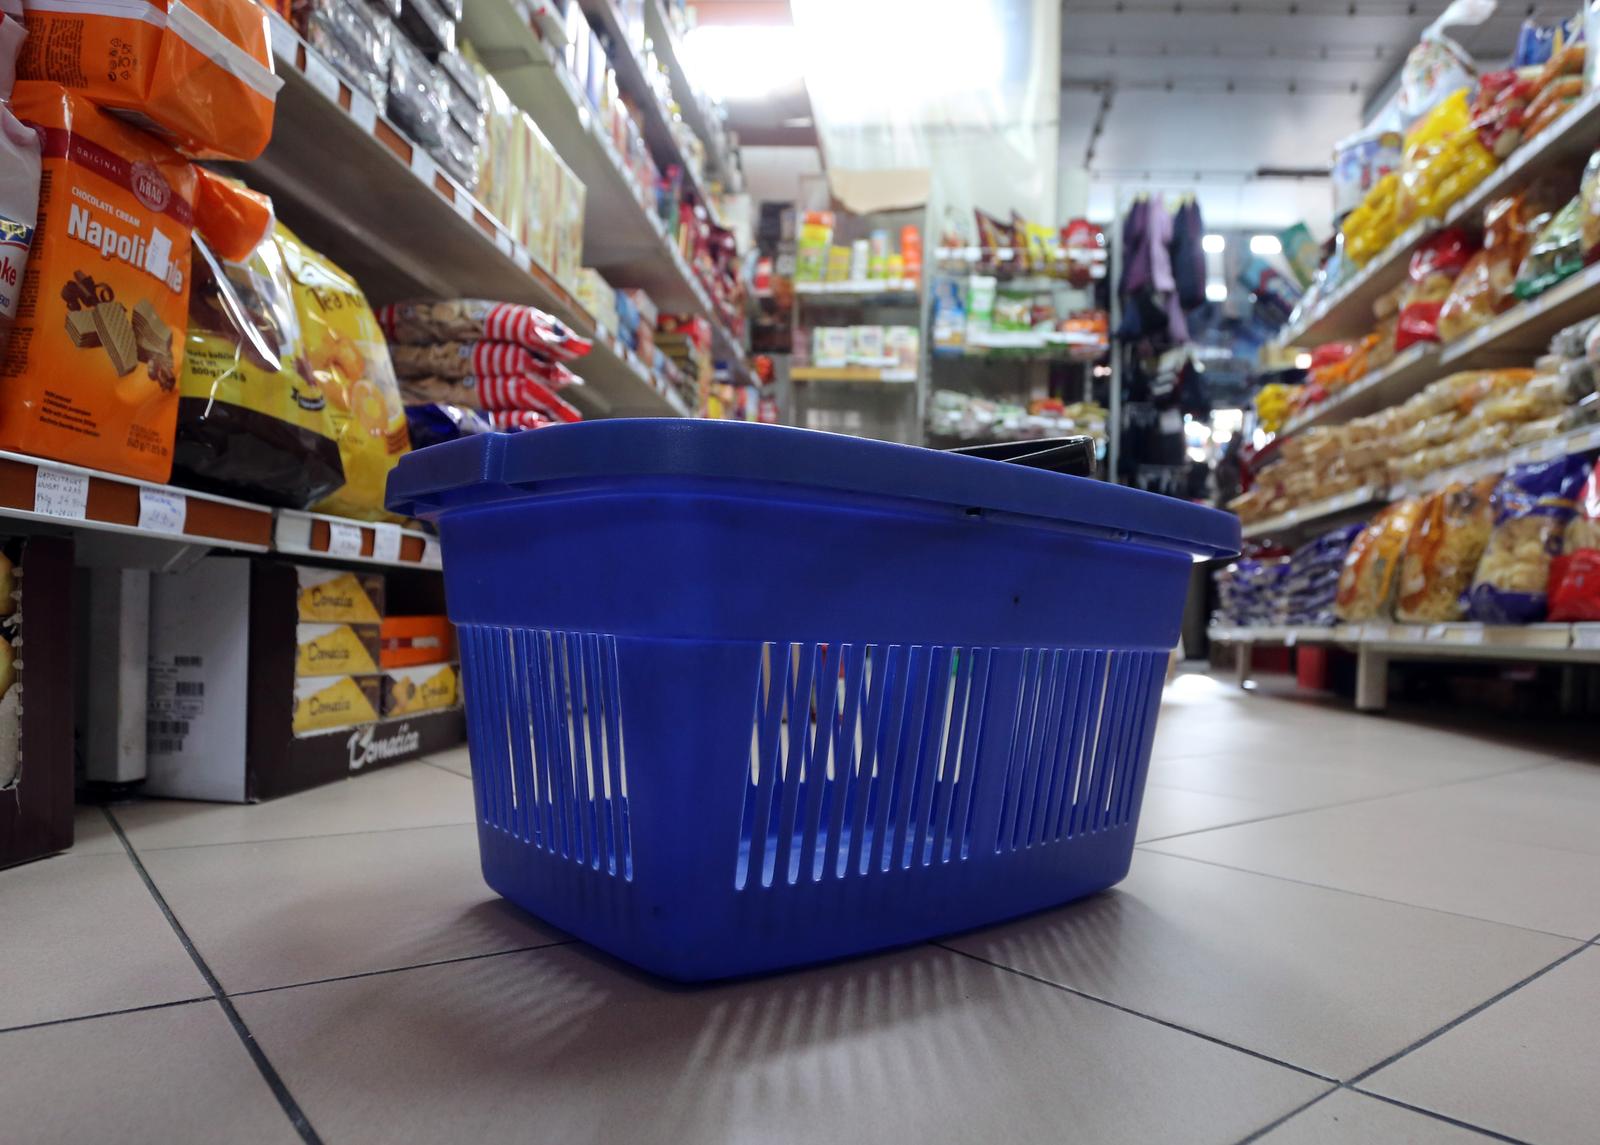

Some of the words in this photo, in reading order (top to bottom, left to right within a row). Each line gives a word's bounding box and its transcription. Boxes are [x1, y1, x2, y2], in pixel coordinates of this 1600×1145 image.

[71, 185, 114, 216] CHOCOLATE
[115, 208, 141, 227] CREAM
[0, 256, 17, 286] ke
